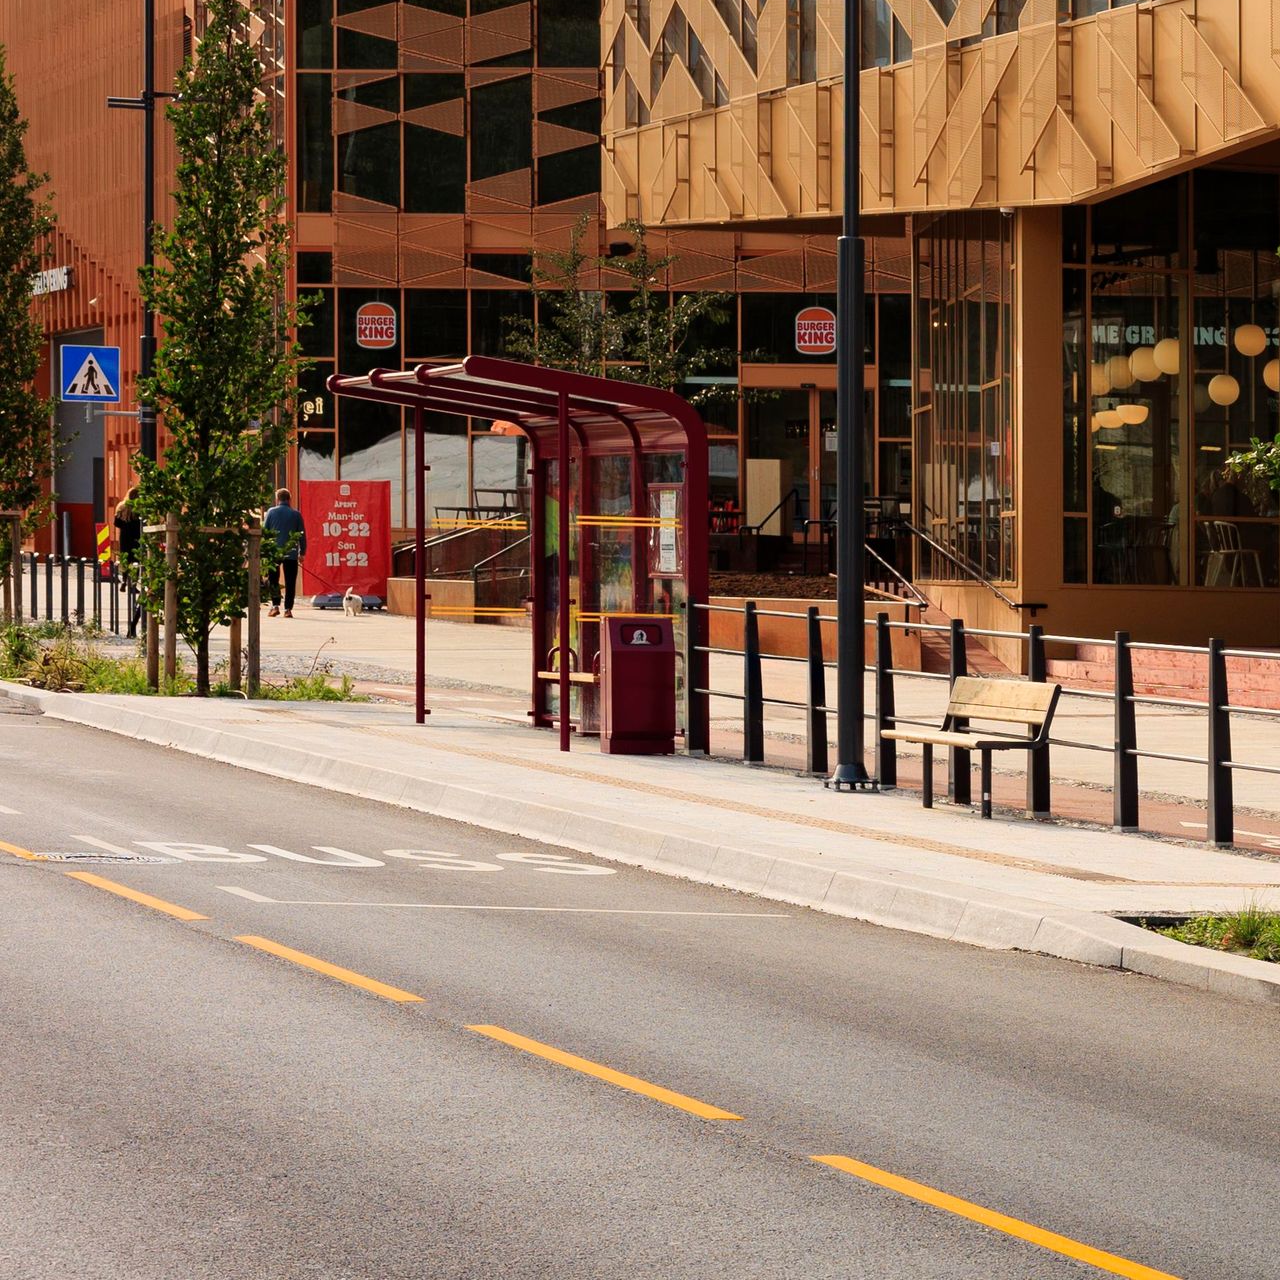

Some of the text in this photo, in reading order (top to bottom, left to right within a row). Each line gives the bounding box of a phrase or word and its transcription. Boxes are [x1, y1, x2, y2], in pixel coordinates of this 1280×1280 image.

[358, 317, 394, 326] BURGER
[797, 322, 834, 331] BURGER
[358, 326, 394, 338] KING
[797, 331, 834, 344] KING
[322, 522, 370, 537] 10-22
[325, 552, 369, 567] 11-22
[134, 840, 617, 875] BUSS
